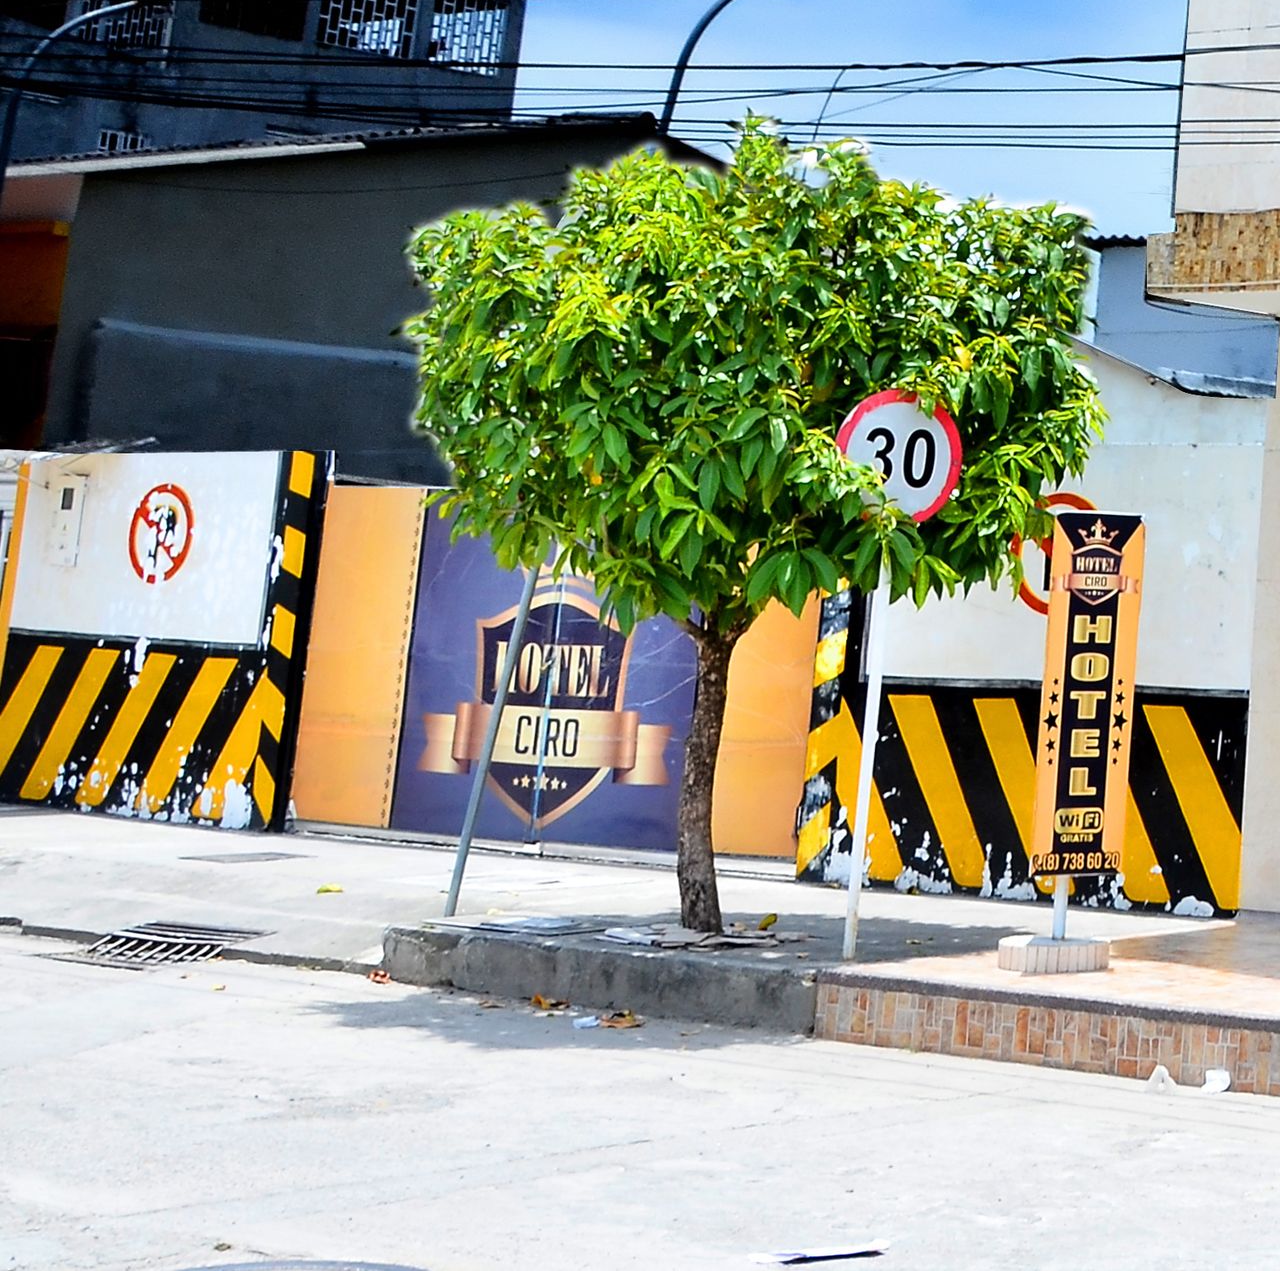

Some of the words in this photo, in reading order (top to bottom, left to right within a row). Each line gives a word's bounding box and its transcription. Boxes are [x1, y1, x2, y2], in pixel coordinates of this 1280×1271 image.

[866, 427, 936, 488] 30
[1076, 557, 1117, 572] HOTEL
[1084, 576, 1107, 587] CIRO
[1069, 614, 1112, 796] HOTEL
[515, 715, 579, 757] CIRO
[1060, 812, 1100, 828] WiFi
[1060, 833, 1094, 843] GRATIS
[1042, 853, 1059, 870] (8)
[1062, 852, 1085, 870] 738
[1087, 852, 1102, 869] 60
[1104, 852, 1120, 869] 20
